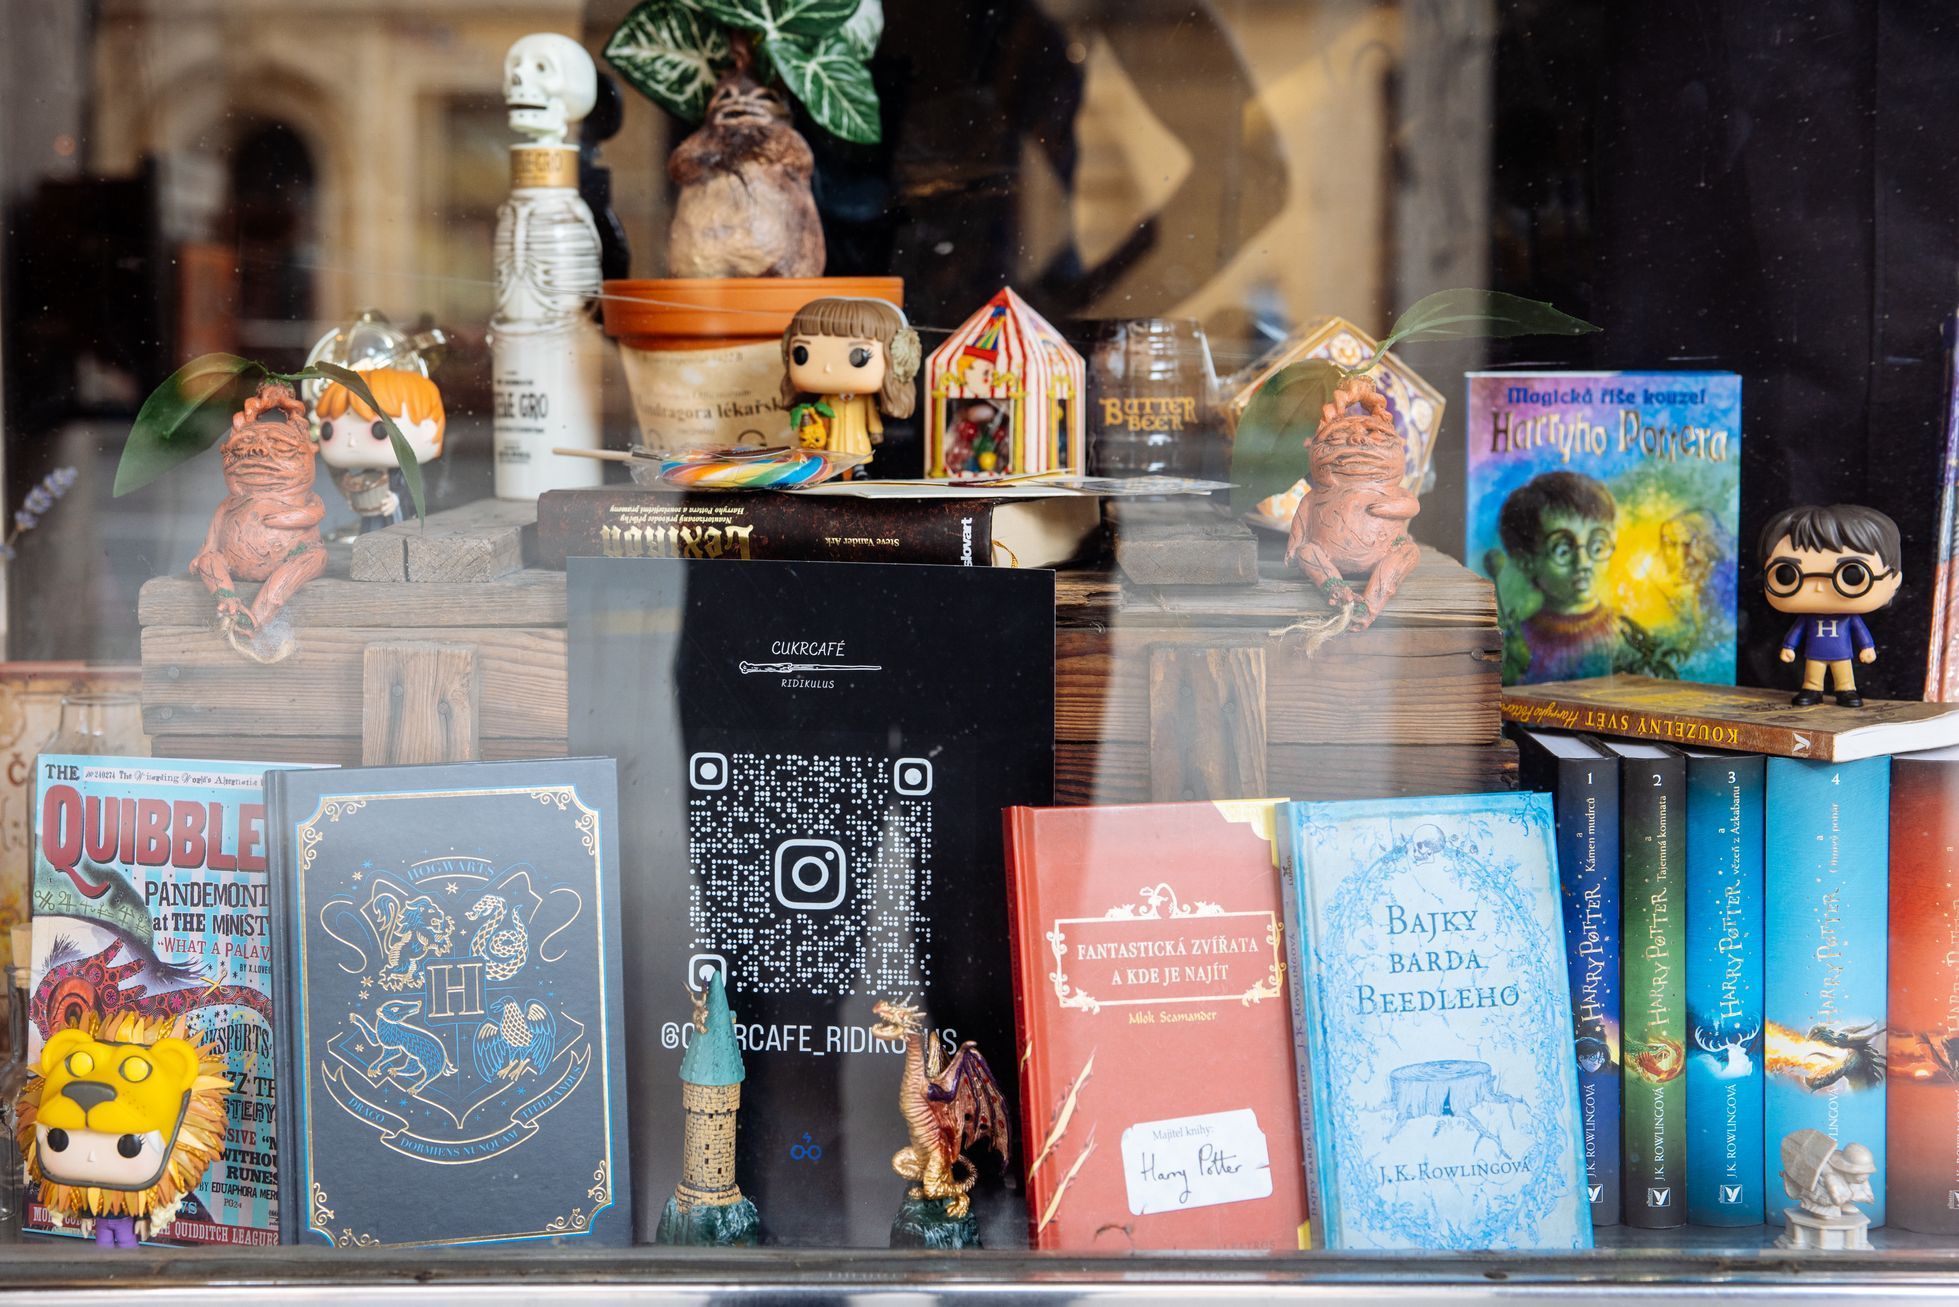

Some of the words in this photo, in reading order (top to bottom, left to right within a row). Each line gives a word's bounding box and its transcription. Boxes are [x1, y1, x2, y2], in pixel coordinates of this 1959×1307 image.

[1507, 387, 1594, 407] Magická
[1600, 387, 1636, 405] říše
[1642, 387, 1707, 405] kouzel
[1100, 396, 1199, 427] BUTTER
[1123, 414, 1185, 432] BEER
[1491, 408, 1608, 463] Harryho
[1618, 408, 1729, 464] Pottera
[824, 536, 841, 547] Ark
[843, 537, 874, 547] Vander
[876, 537, 900, 548] Steve
[960, 517, 973, 567] slovart
[1815, 620, 1840, 639] H
[771, 640, 846, 657] CUKRCAFÉ
[781, 678, 835, 689] RIDIKULUS
[1535, 701, 1580, 728] Harryho
[1584, 711, 1629, 731] SVĚT
[1636, 716, 1739, 744] KOUZELNÝ
[45, 764, 80, 781] THE
[1587, 772, 1593, 785] 1
[1652, 774, 1662, 787] 2
[1728, 771, 1736, 784] 3
[1831, 773, 1840, 785] 4
[1585, 797, 1596, 835] mudrců
[1657, 795, 1667, 838] komnata
[1730, 786, 1741, 835] Azkabanu
[1585, 837, 1596, 872] Kámen
[1656, 841, 1668, 882] Tajemná
[1730, 846, 1740, 875] vězeň
[407, 860, 496, 881] HOGWARTS
[153, 913, 168, 931] at
[171, 913, 206, 932] THE
[1385, 904, 1478, 943] BAJKY
[1579, 883, 1604, 957] POTTER
[1645, 887, 1670, 962] POTTER
[1718, 879, 1743, 953] POTTER
[211, 942, 220, 955] A
[225, 942, 272, 961] PALAV
[1077, 937, 1187, 961] FANTASTICKÁ
[1191, 935, 1260, 956] ZVÍŘATA
[1389, 949, 1486, 974] BARDA
[1111, 969, 1123, 986] A
[1127, 967, 1160, 985] KDE
[1163, 966, 1181, 987] JE
[1184, 962, 1230, 984] NAJÍT
[1719, 953, 1744, 1019] HARRY
[427, 963, 485, 1018] H
[1354, 984, 1520, 1016] BEEDLEHO
[1580, 957, 1605, 1022] HARRY
[1647, 962, 1670, 1026] HARRY
[1128, 1010, 1156, 1025] Mlok
[1160, 1010, 1218, 1024] Scamander
[348, 1097, 385, 1124] DRACO
[1583, 1083, 1596, 1158] ROWLINGOVÁ
[1724, 1083, 1737, 1159] ROWLINGOVÁ
[1652, 1087, 1665, 1162] ROWLINGOVÁ
[400, 1136, 460, 1157] DORMIENS
[1140, 1151, 1192, 1204] Harry
[1198, 1143, 1243, 1176] Potter
[174, 1221, 229, 1242] QUIDDITCH
